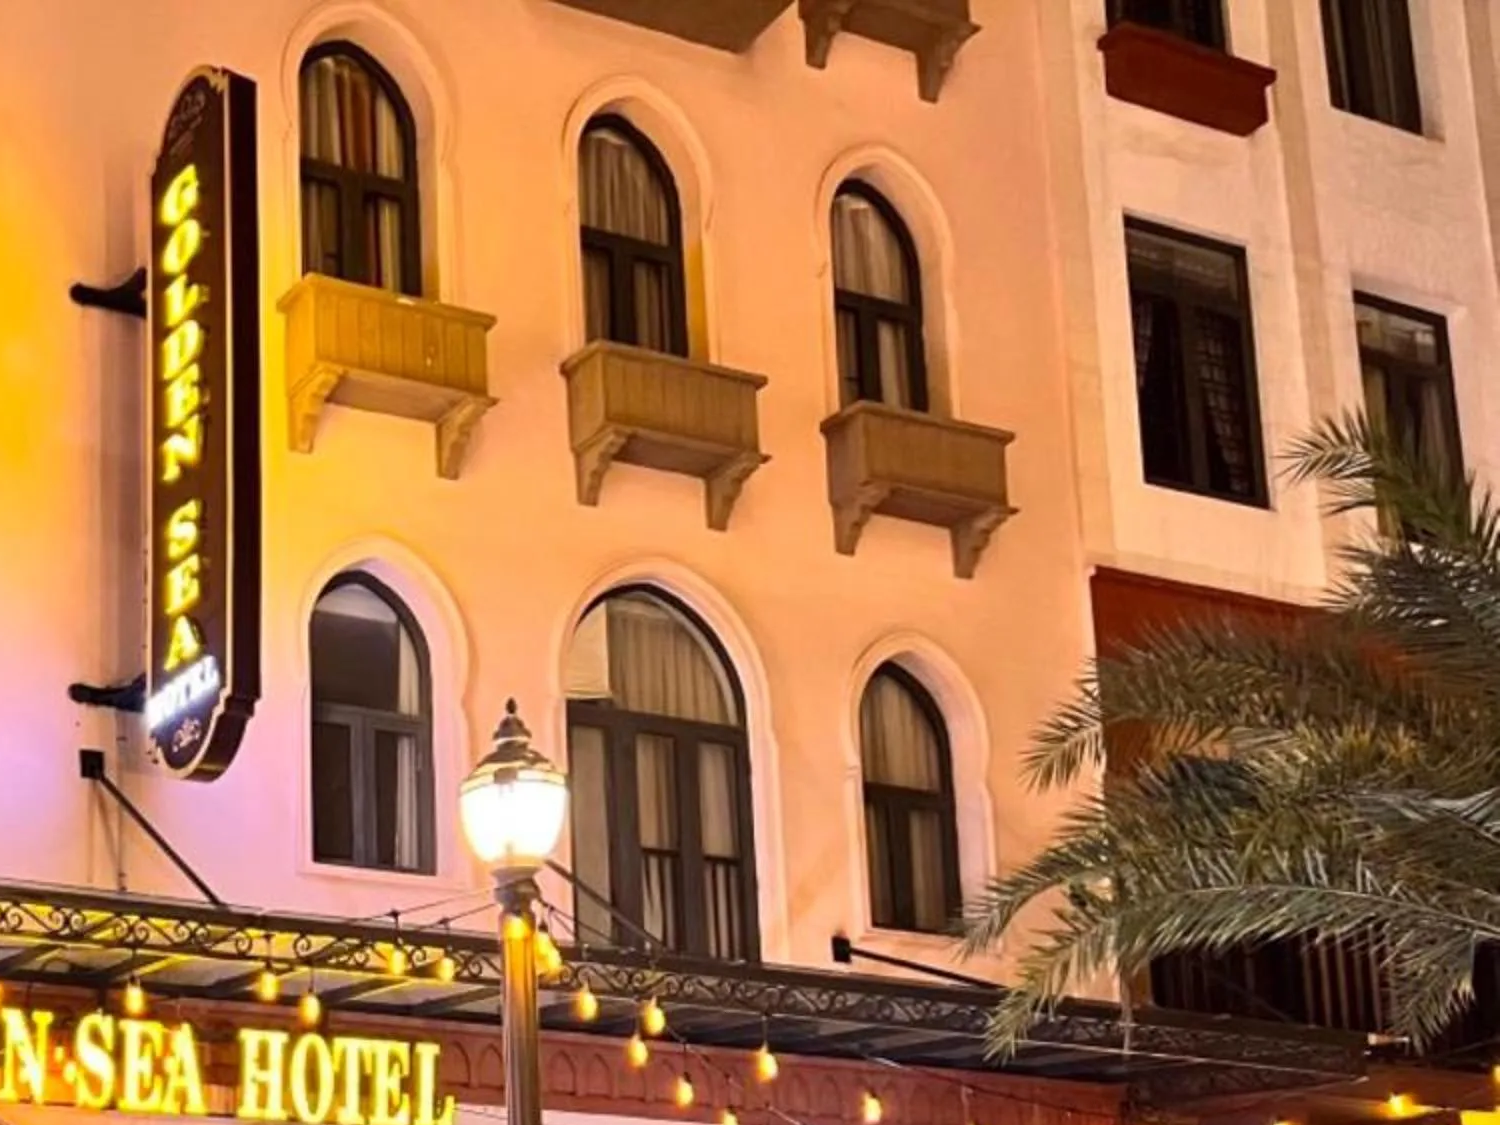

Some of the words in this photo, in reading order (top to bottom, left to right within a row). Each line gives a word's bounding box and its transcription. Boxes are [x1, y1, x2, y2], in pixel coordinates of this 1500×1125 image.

[159, 163, 200, 482] GOLDEN
[164, 498, 201, 671] SEA
[74, 1013, 207, 1115] SEA
